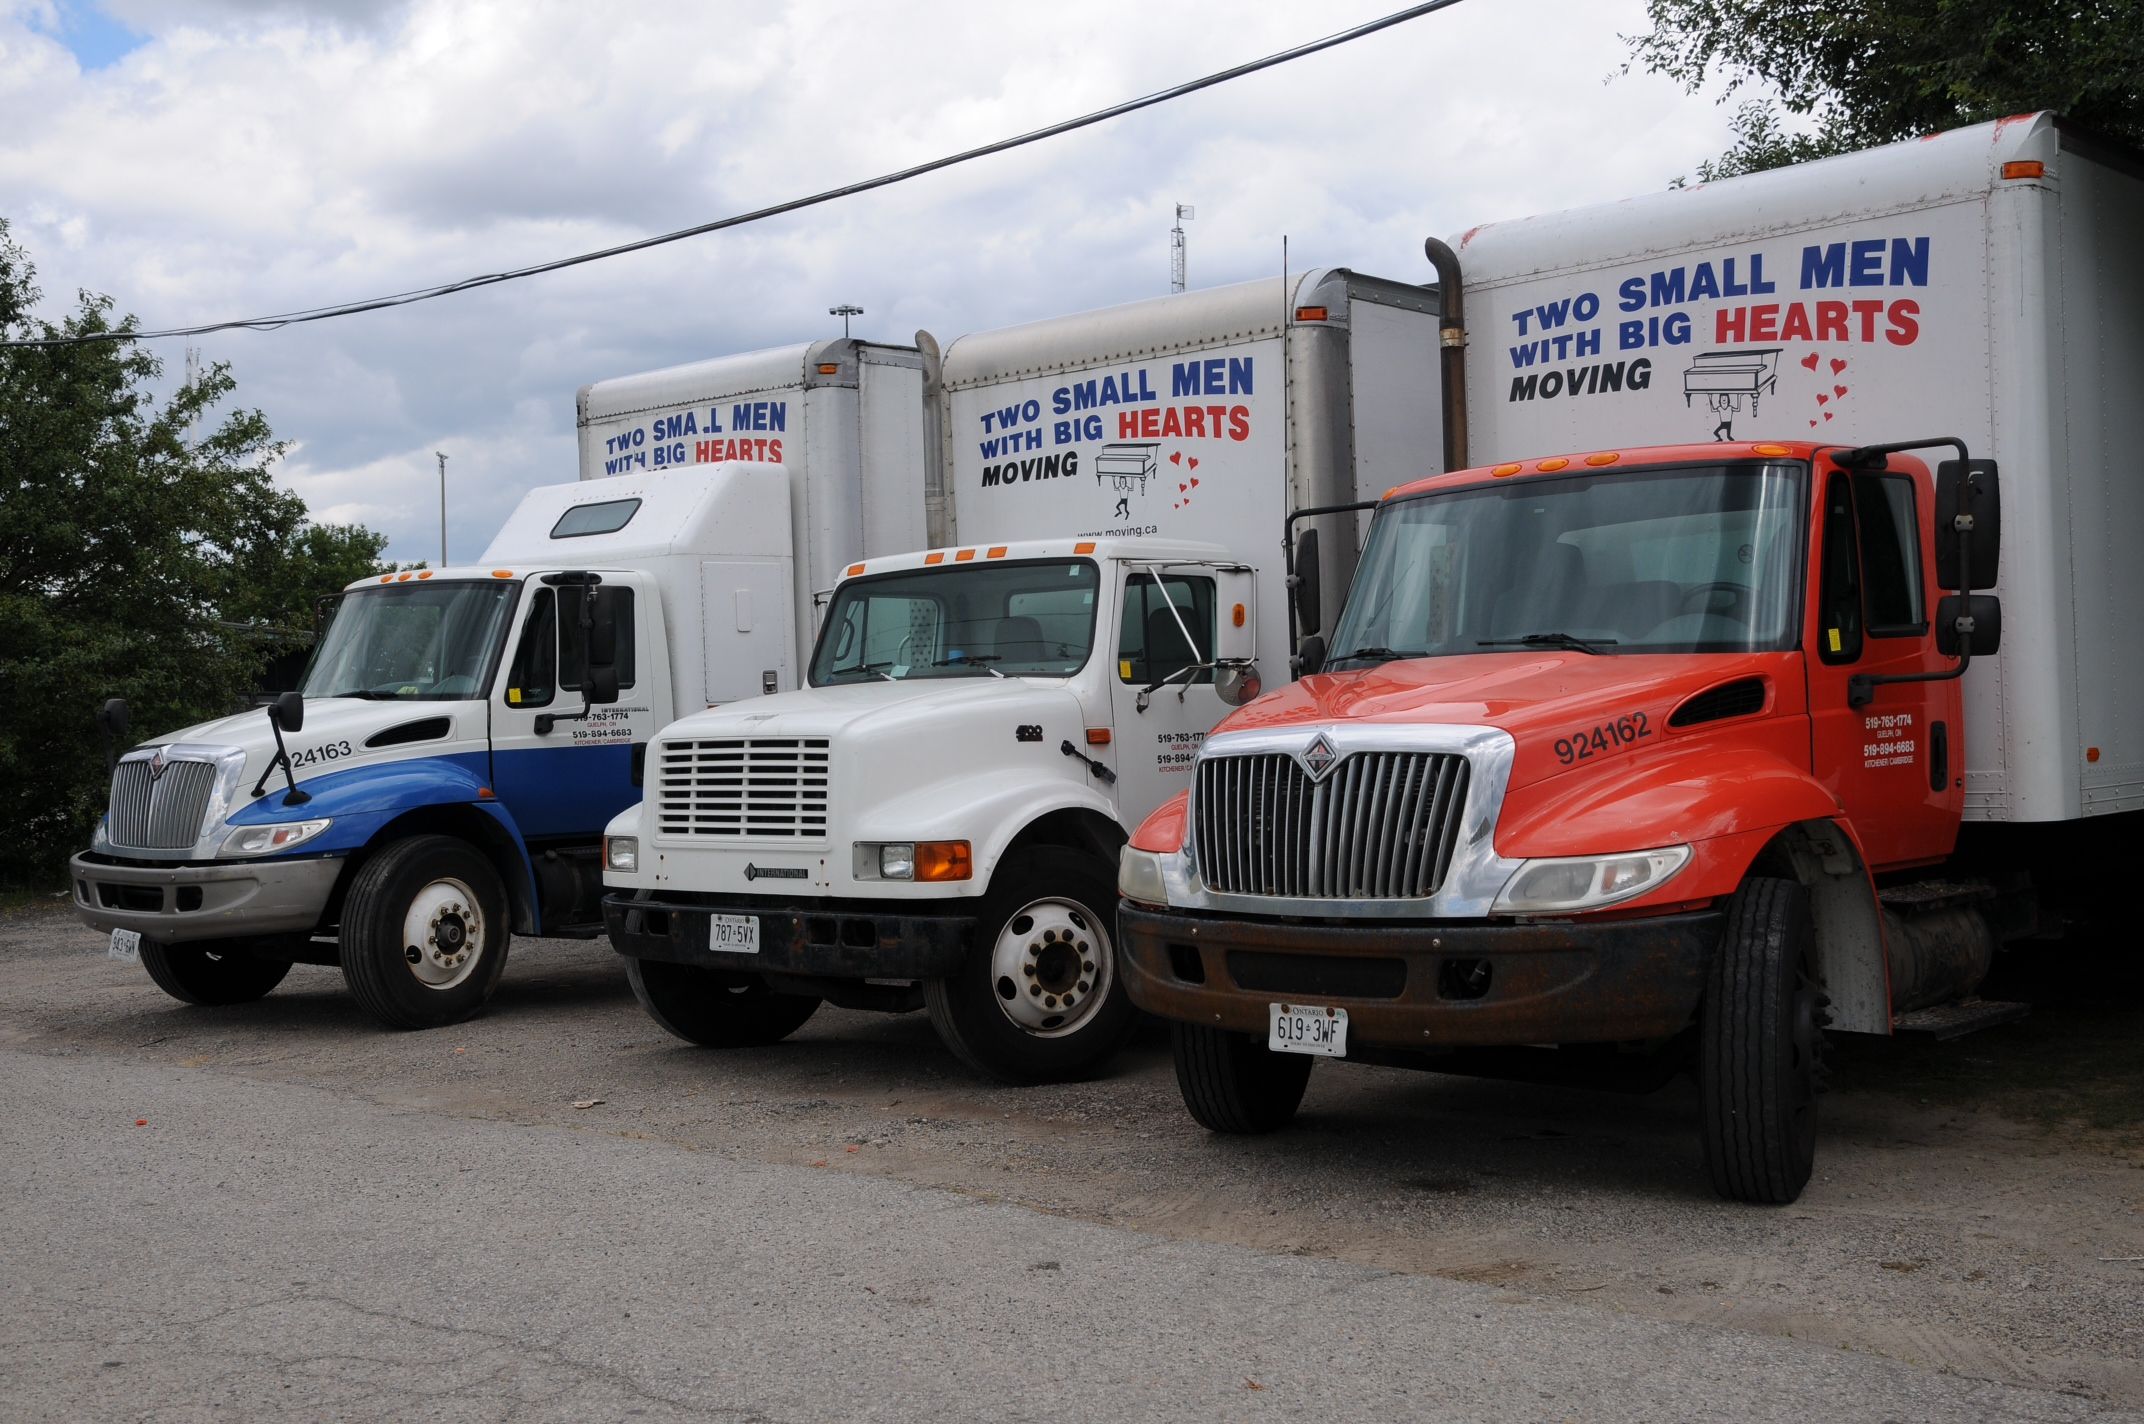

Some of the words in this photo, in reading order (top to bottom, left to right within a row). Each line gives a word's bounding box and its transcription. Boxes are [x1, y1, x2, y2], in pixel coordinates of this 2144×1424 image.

[1512, 293, 1599, 337] TWO
[1618, 254, 1775, 312] SMALL
[1800, 237, 1930, 289] MEN
[1509, 329, 1600, 369] WITH
[1619, 312, 1691, 350] BIG
[1715, 298, 1920, 346] HEARTS
[980, 400, 1040, 435] TWO
[1052, 369, 1156, 414] SMALL
[1172, 357, 1253, 397] MEN
[1509, 358, 1652, 402] MOVING
[606, 428, 645, 455] TWO
[653, 407, 722, 442] SMAL
[733, 402, 786, 432] MEN
[980, 428, 1042, 460] WITH
[1054, 415, 1103, 445] BIG
[1119, 405, 1250, 441] HEARTS
[654, 442, 685, 466] BIG
[695, 438, 782, 464] HEARTS
[981, 451, 1078, 487] MOVING
[572, 729, 632, 738] 519-894-6683
[1157, 732, 1209, 743] 519-763-177
[1865, 714, 1912, 729] 519-763-1774
[1554, 711, 1652, 765] 924162
[1864, 740, 1915, 757] 519-894-6683
[716, 924, 731, 941] 787
[738, 925, 754, 944] 5VX
[1292, 1007, 1323, 1016] ONTARIO
[1278, 1016, 1303, 1040] 619
[1313, 1018, 1339, 1043] 3WF
